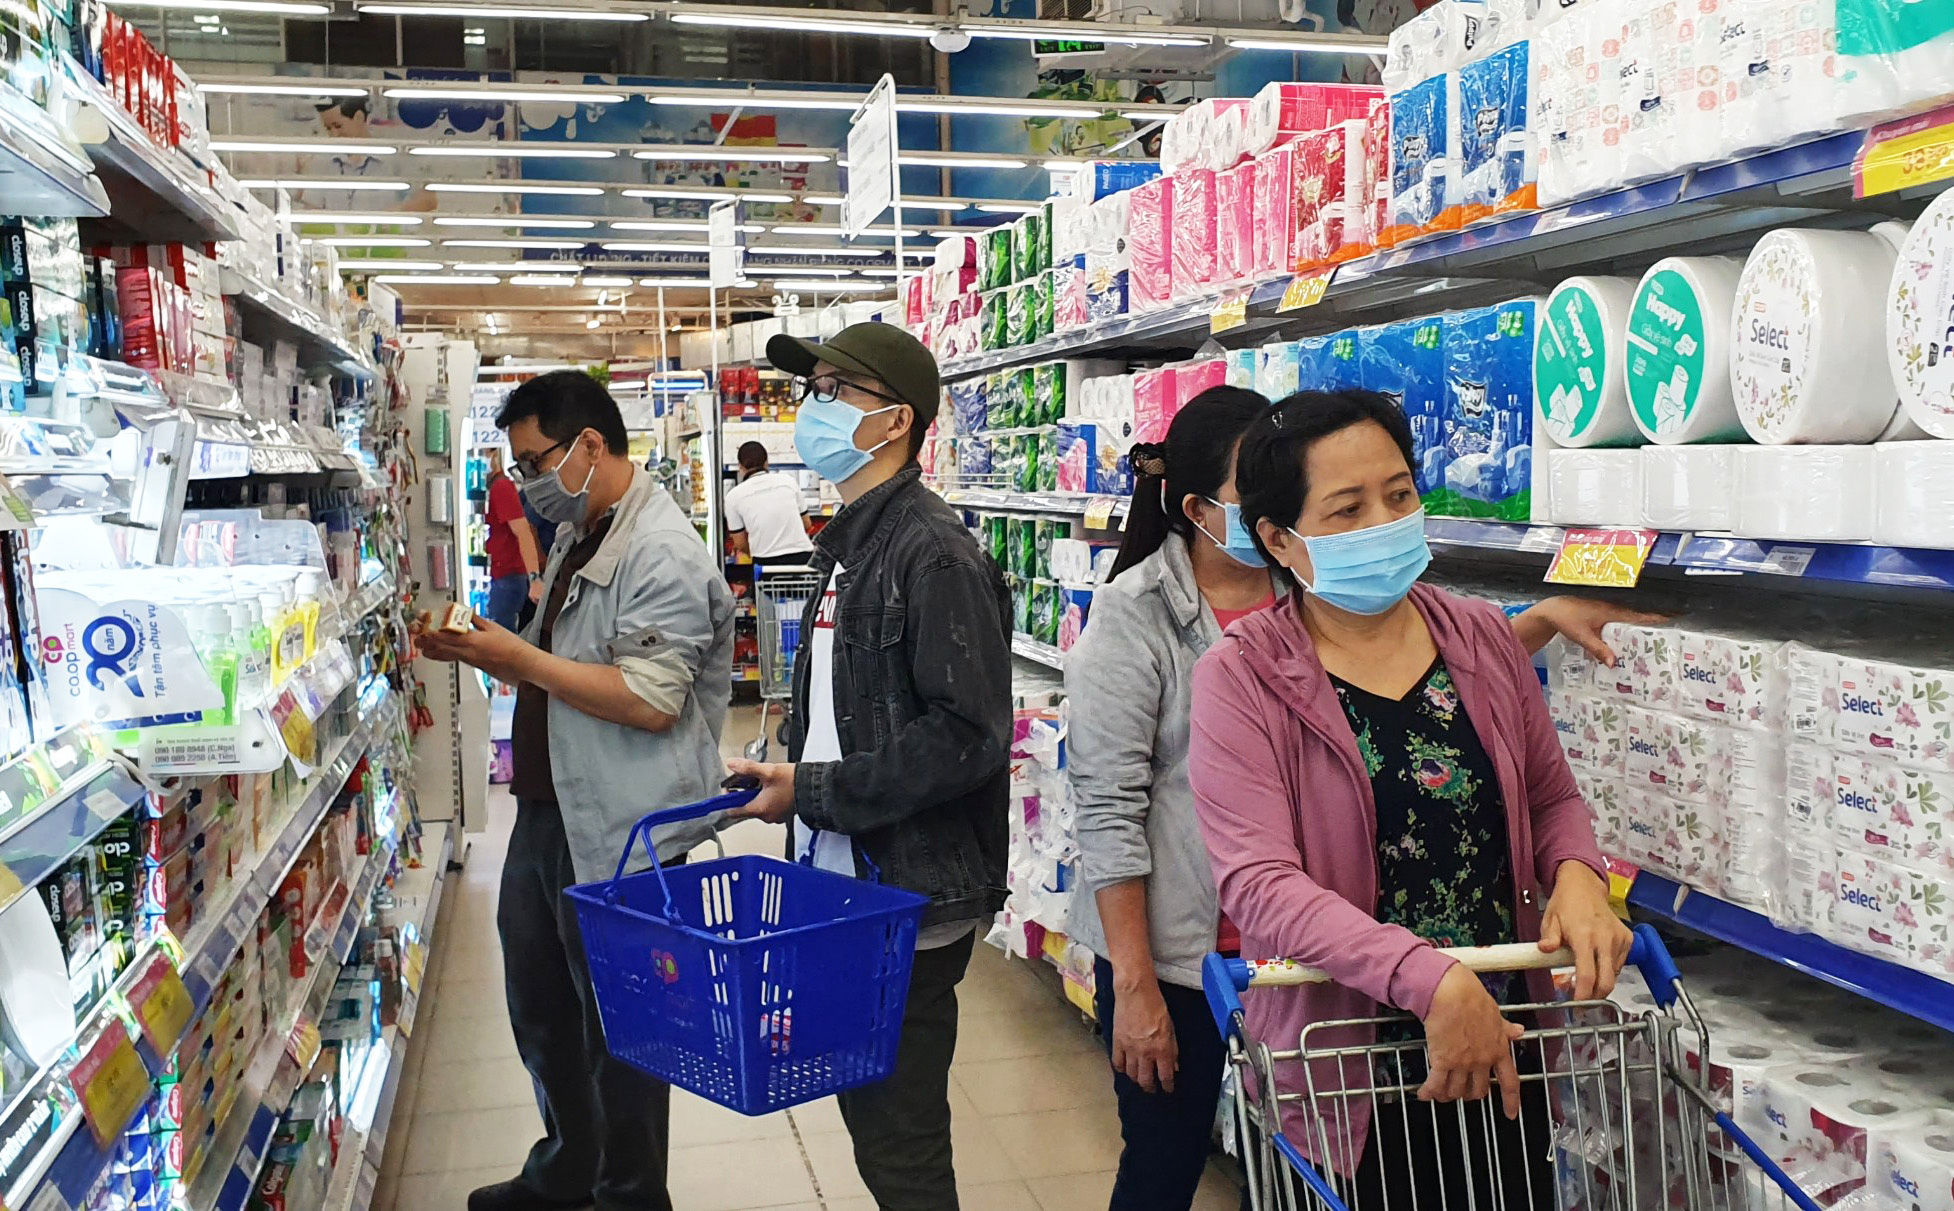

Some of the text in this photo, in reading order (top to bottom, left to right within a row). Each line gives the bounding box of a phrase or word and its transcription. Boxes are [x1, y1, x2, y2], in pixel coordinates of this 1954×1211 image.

[11, 234, 24, 277] closeup
[18, 290, 31, 332] closeup
[1646, 292, 1687, 332] Happy
[1750, 318, 1789, 351] Select
[20, 345, 32, 388] closeup
[1683, 663, 1717, 685] Select
[1841, 692, 1885, 717] Select
[1629, 736, 1660, 758] Select
[1837, 787, 1879, 814] Select
[1628, 816, 1658, 839] Select
[49, 884, 61, 923] closeup
[1840, 883, 1882, 913] Select
